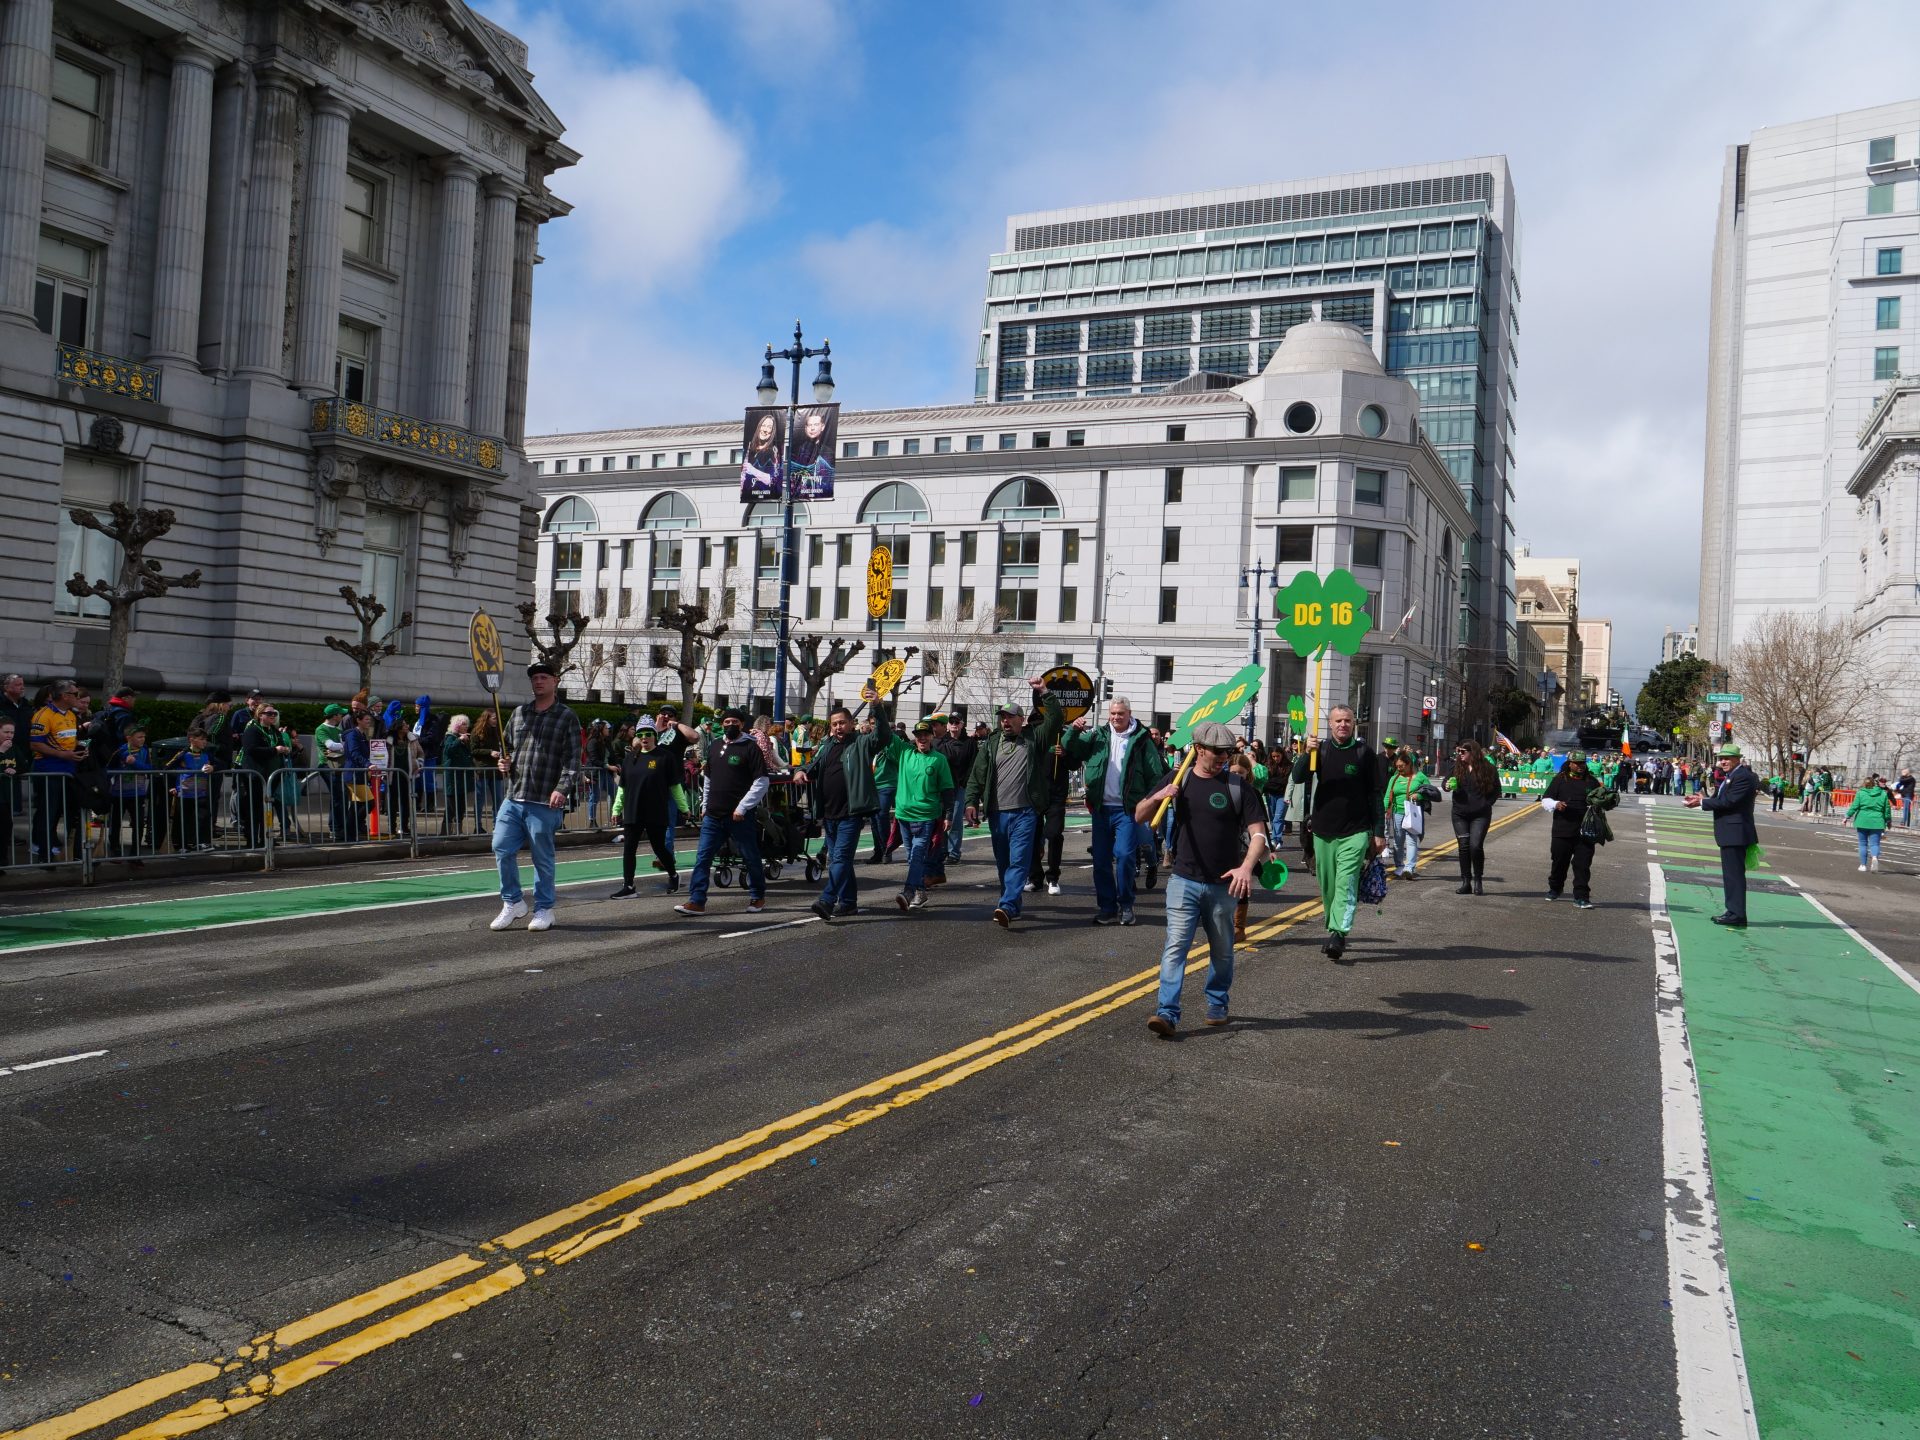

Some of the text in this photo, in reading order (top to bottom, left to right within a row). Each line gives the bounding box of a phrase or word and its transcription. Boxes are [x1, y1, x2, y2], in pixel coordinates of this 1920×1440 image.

[1294, 602, 1353, 626] DC 16
[1062, 690, 1079, 698] FIGHTS
[1187, 683, 1248, 727] DC 16
[1290, 709, 1298, 721] DC
[1518, 777, 1547, 789] IRISH
